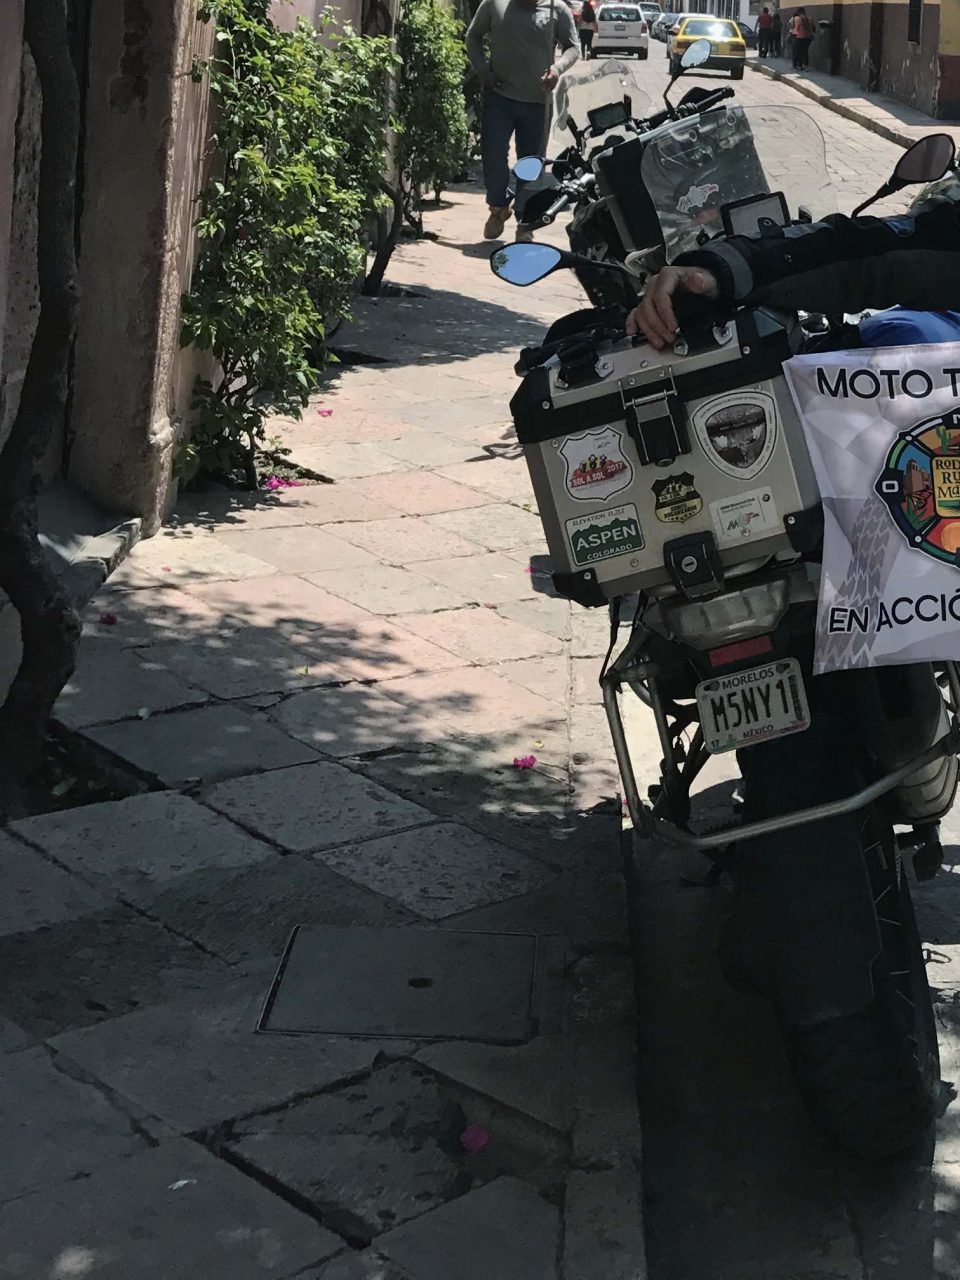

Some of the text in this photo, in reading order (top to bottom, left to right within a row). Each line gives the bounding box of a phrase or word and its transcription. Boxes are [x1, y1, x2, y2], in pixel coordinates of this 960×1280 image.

[816, 367, 934, 400] MOTO
[607, 463, 623, 473] 2017
[882, 480, 899, 493] O
[572, 513, 606, 526] ELEVATION
[576, 524, 637, 551] ASPEN
[587, 543, 633, 560] COLORADO
[829, 606, 869, 633] EN
[722, 668, 775, 690] MORELOS
[710, 679, 789, 733] M5NY1
